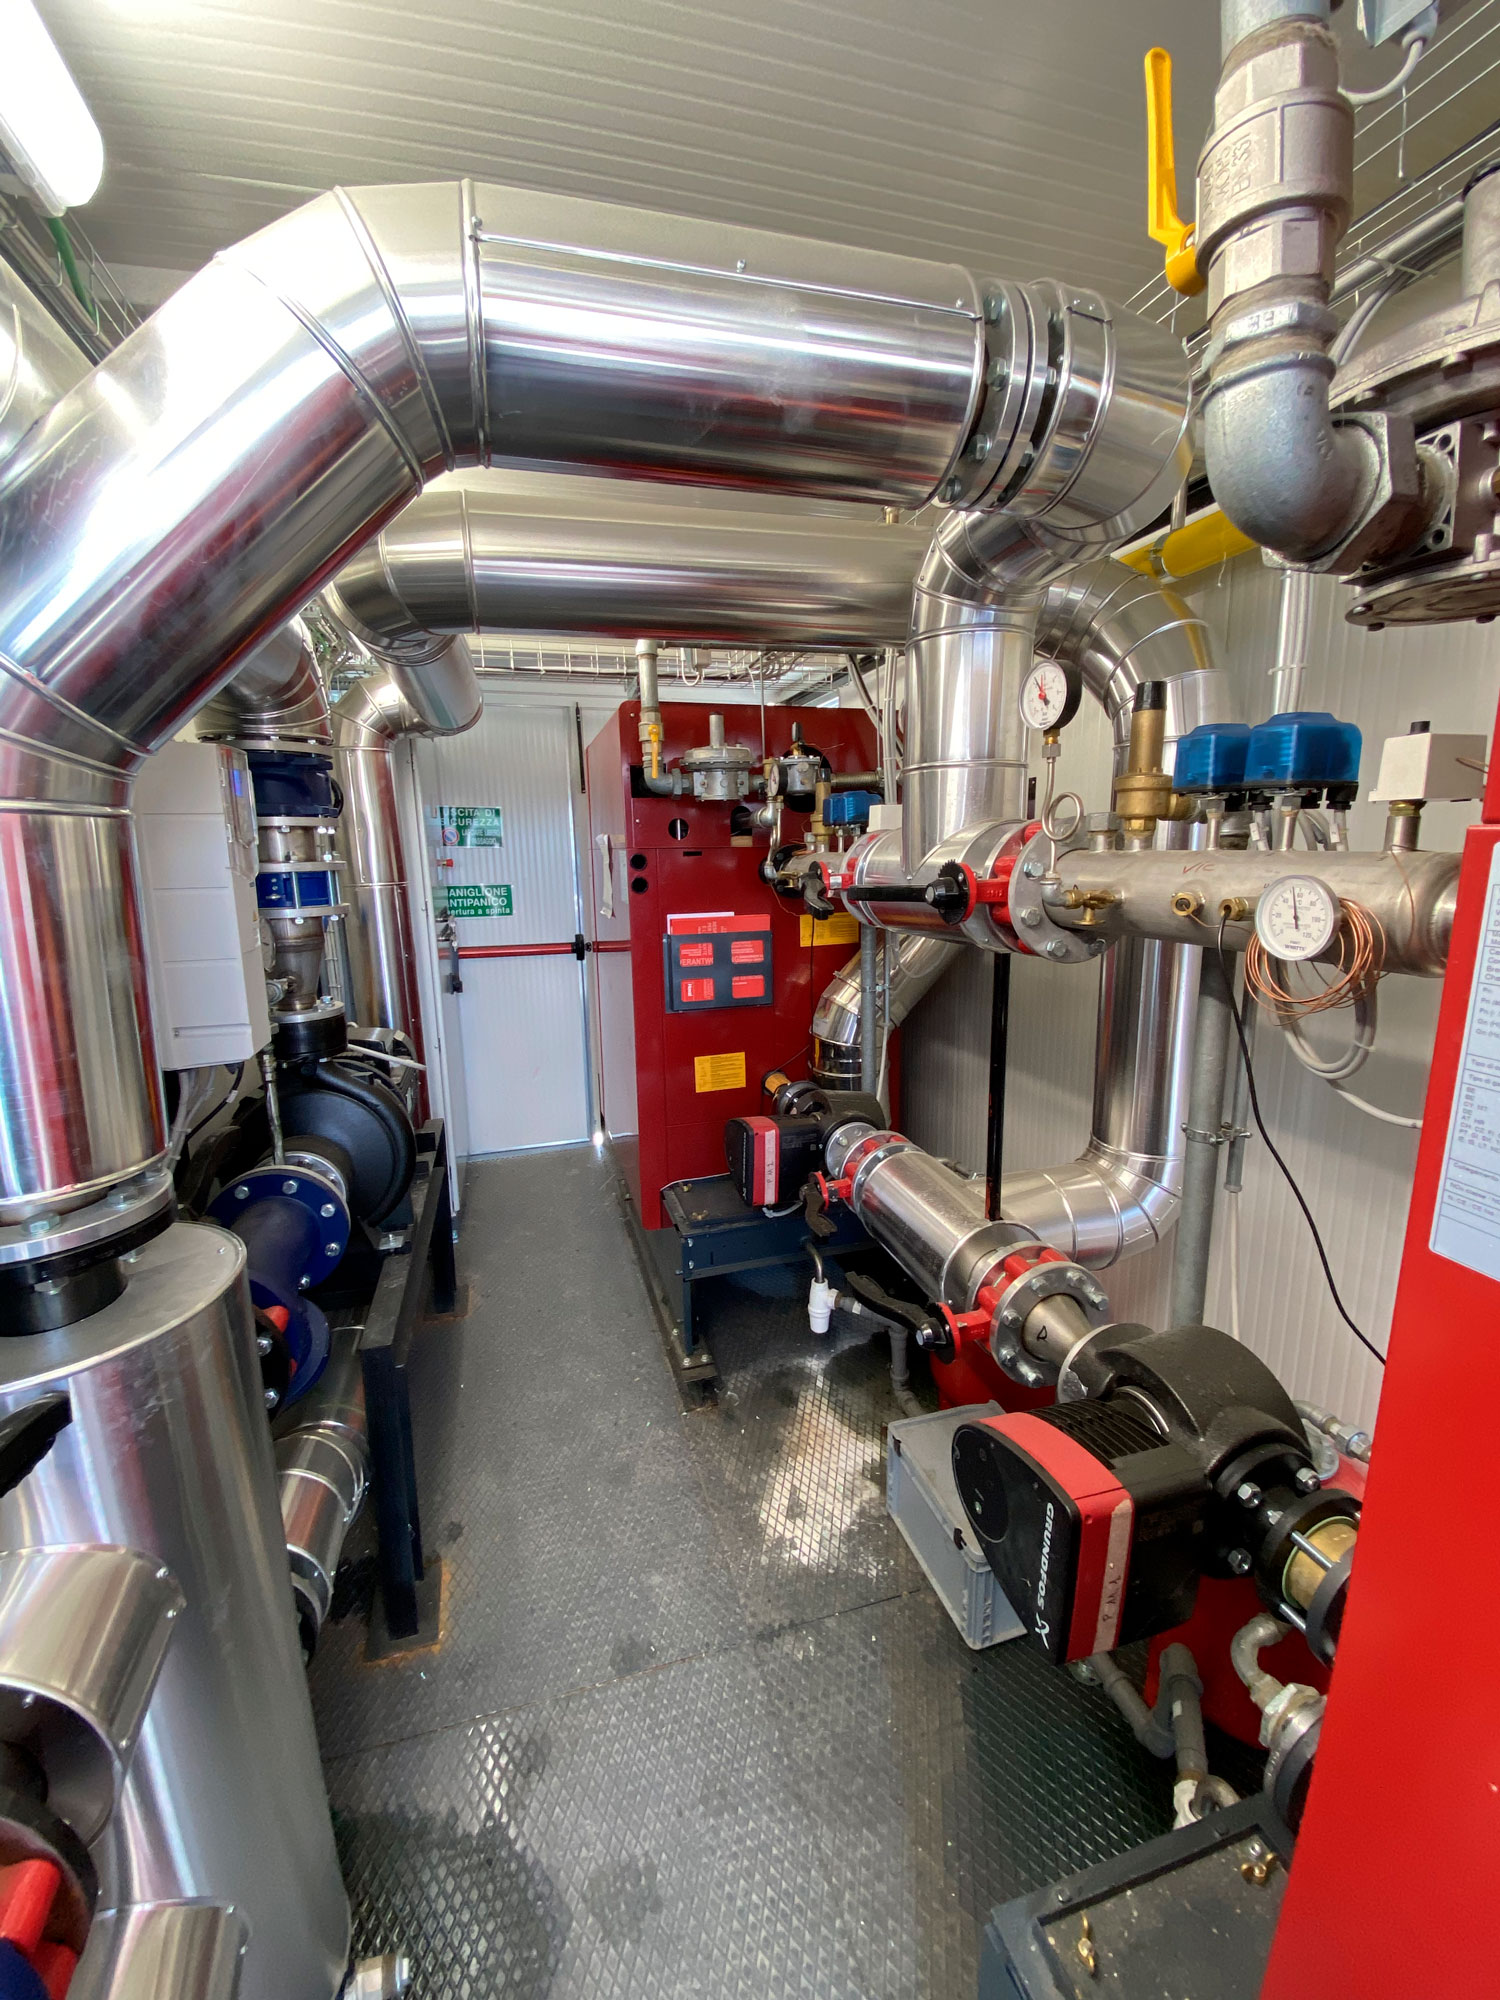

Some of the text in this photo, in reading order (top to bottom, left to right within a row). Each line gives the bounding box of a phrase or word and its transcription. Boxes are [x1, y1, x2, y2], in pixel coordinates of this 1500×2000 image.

[443, 808, 496, 817] USCITA DI
[448, 887, 508, 897] ANIGLIONE
[448, 897, 508, 908] NTIPANICO
[485, 906, 511, 916] spinta
[1037, 1502, 1055, 1610] GRUNDFOS
